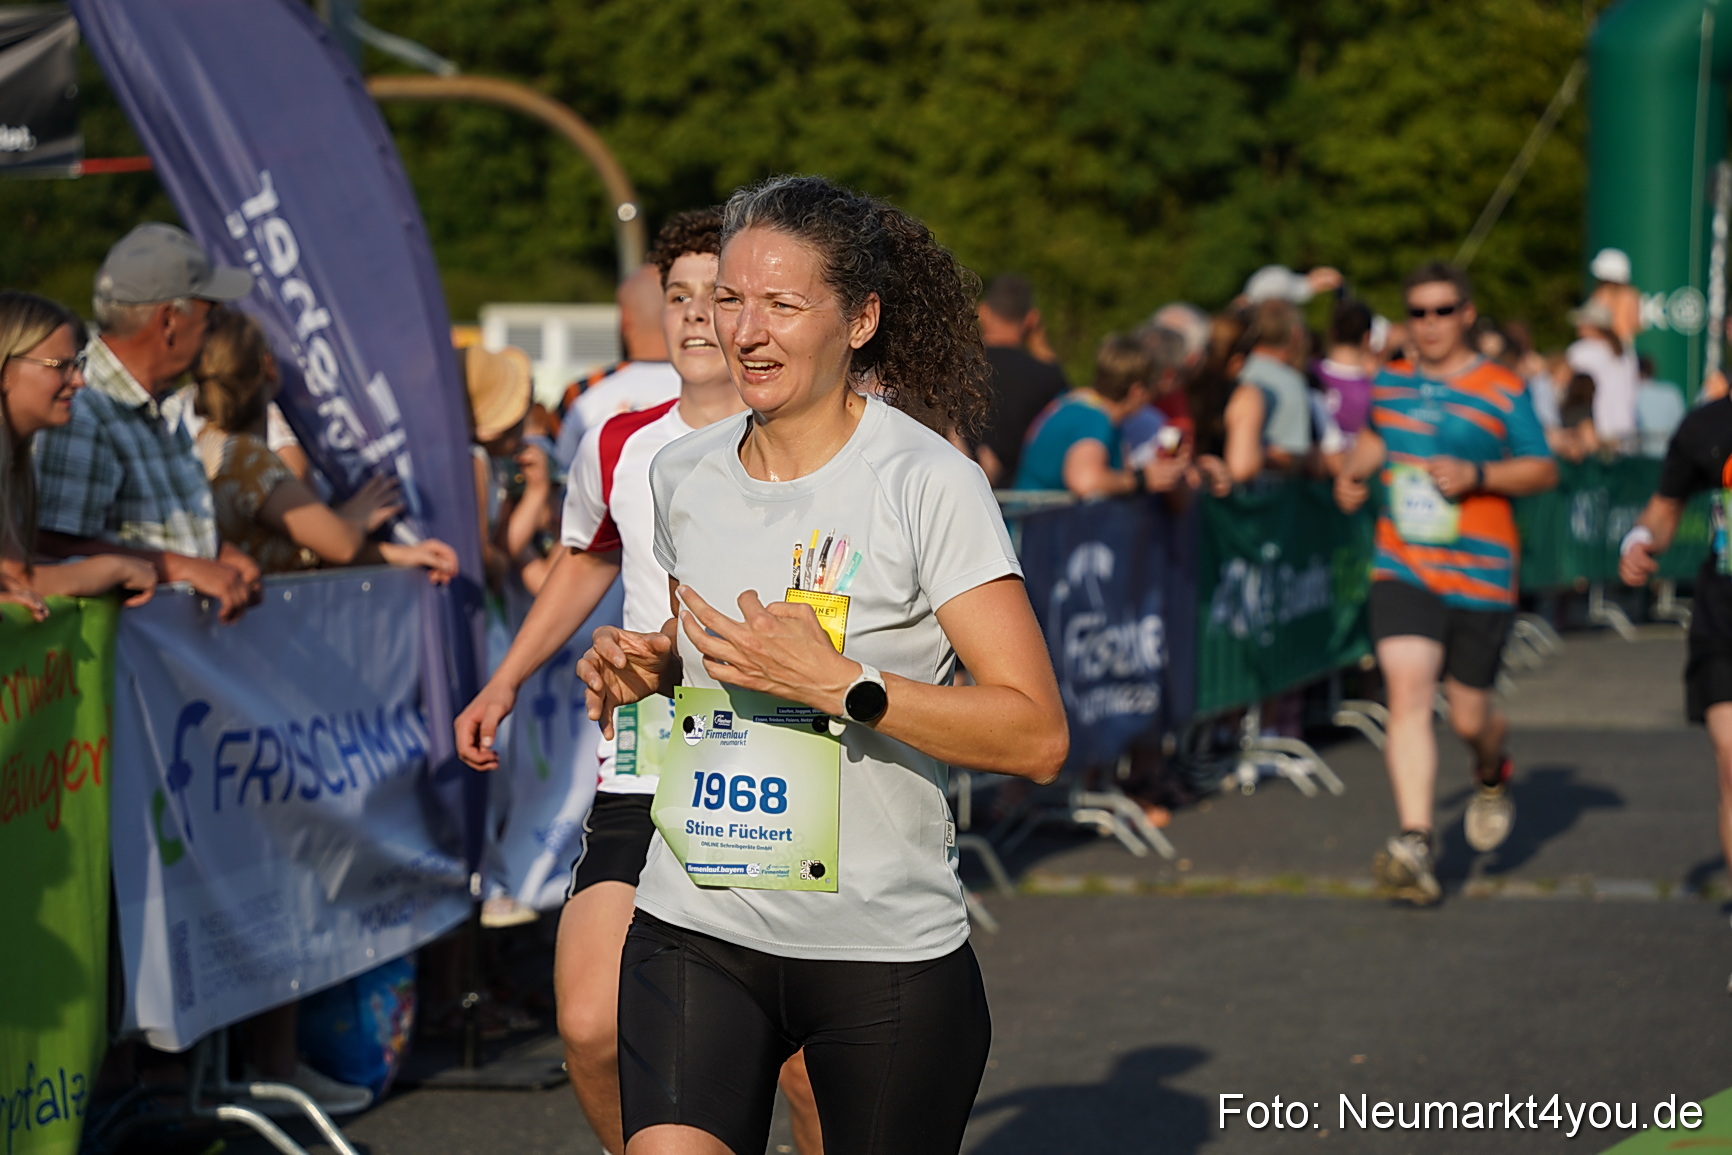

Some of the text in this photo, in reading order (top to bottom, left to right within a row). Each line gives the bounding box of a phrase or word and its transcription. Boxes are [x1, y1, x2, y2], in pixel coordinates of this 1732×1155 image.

[705, 729, 749, 740] Firmenlauf
[213, 703, 428, 812] FRISCHMA
[691, 771, 788, 815] 1968
[685, 819, 793, 842] Stine Fückert
[720, 842, 755, 851] Schreibgeräte
[687, 865, 745, 875] firmenlauf.bayern
